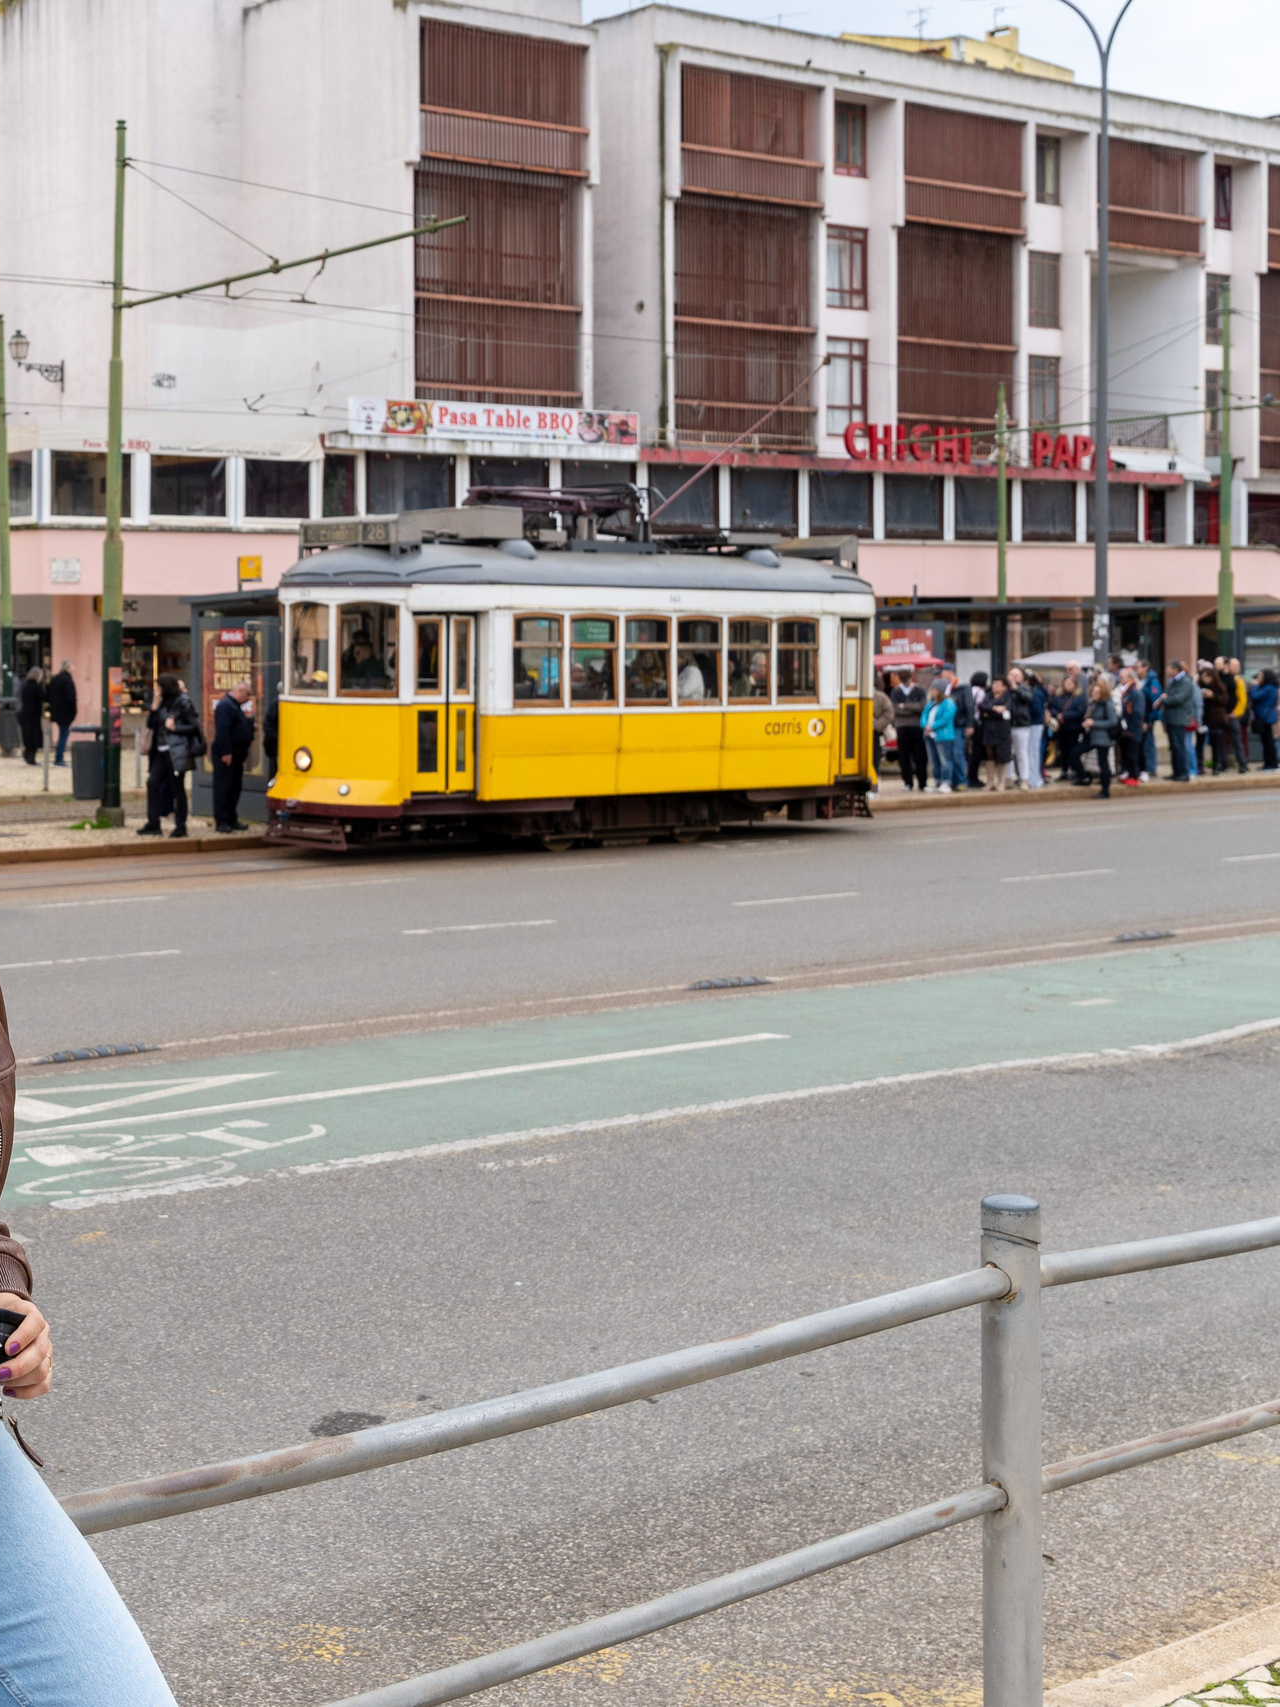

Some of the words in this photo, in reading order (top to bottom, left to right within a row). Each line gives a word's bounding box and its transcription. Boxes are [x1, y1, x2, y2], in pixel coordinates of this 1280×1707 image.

[438, 406, 477, 426] Pasa
[483, 408, 531, 429] Table
[537, 411, 573, 436] BBQ
[843, 422, 971, 465] CHICHI
[366, 523, 386, 541] 28
[765, 717, 802, 736] carris
